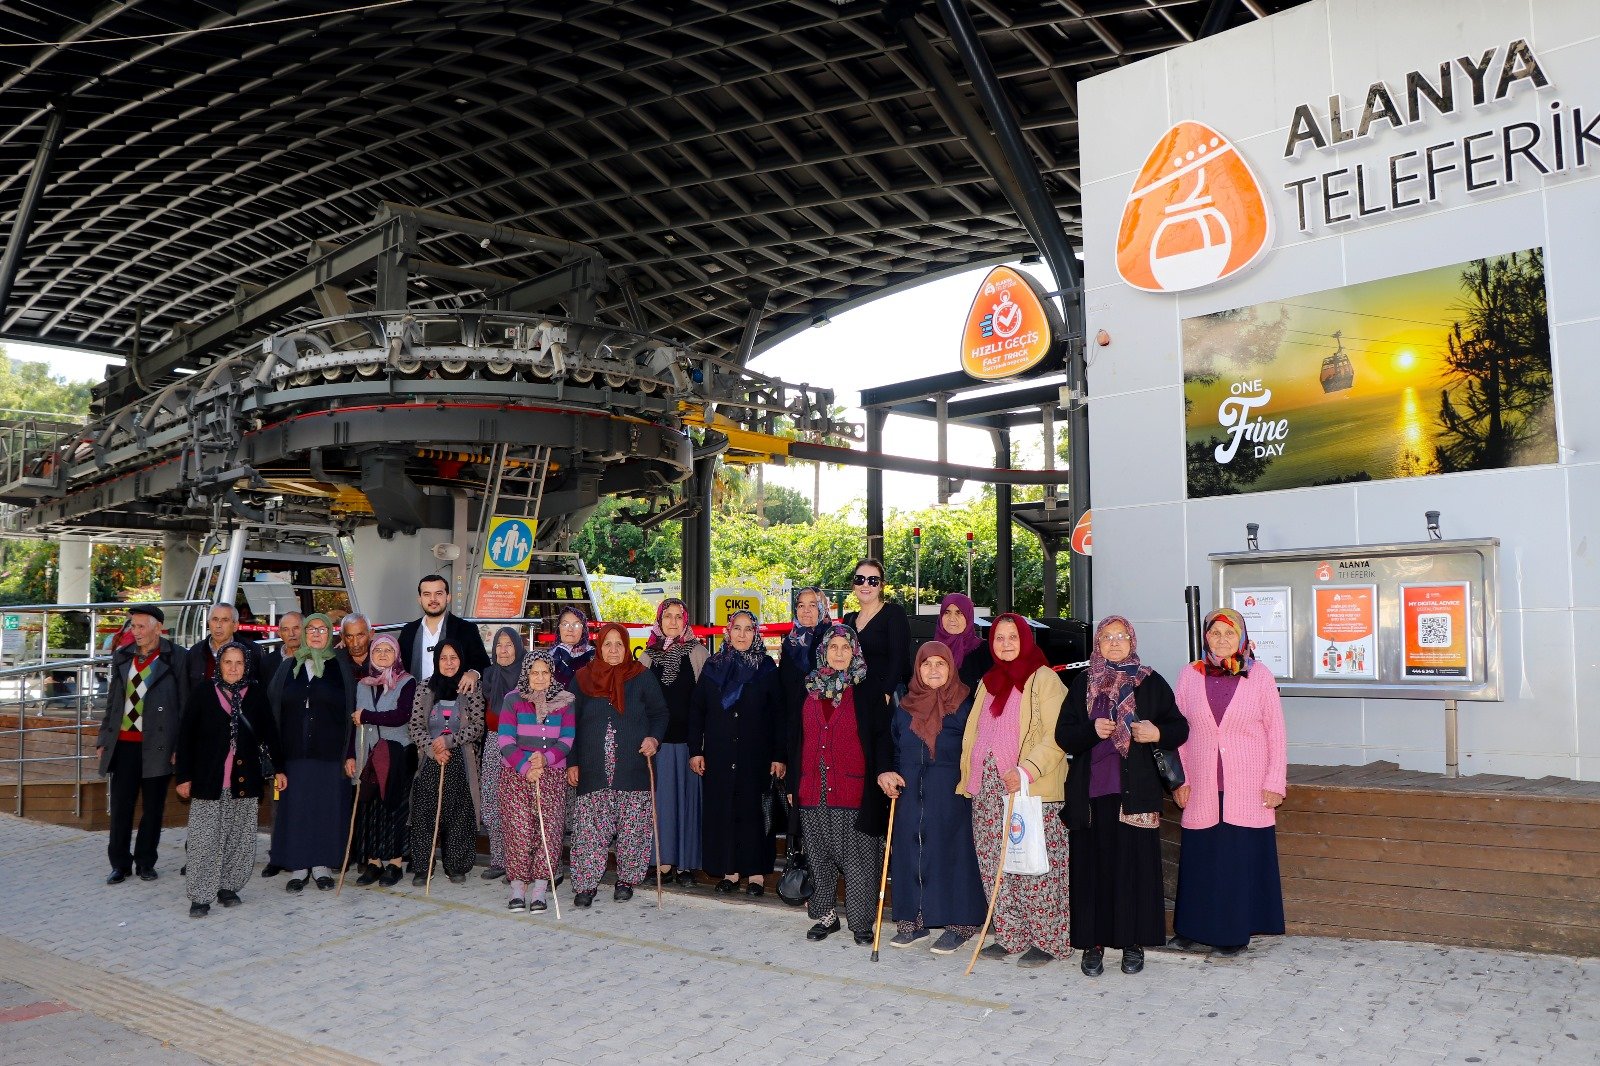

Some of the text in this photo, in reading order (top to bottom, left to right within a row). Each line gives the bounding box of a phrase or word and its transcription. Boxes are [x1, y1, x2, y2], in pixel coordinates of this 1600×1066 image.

[1283, 38, 1554, 159] ALANYA
[1283, 100, 1600, 233] TELEFERİK
[972, 331, 1039, 358] HIZLI GEÇİŞ
[983, 356, 1001, 367] FAST
[1004, 349, 1028, 361] TRACK
[1230, 379, 1263, 395] ONE
[1214, 388, 1290, 464] Fine
[1254, 443, 1286, 459] DAY
[1339, 560, 1370, 569] ALANYA
